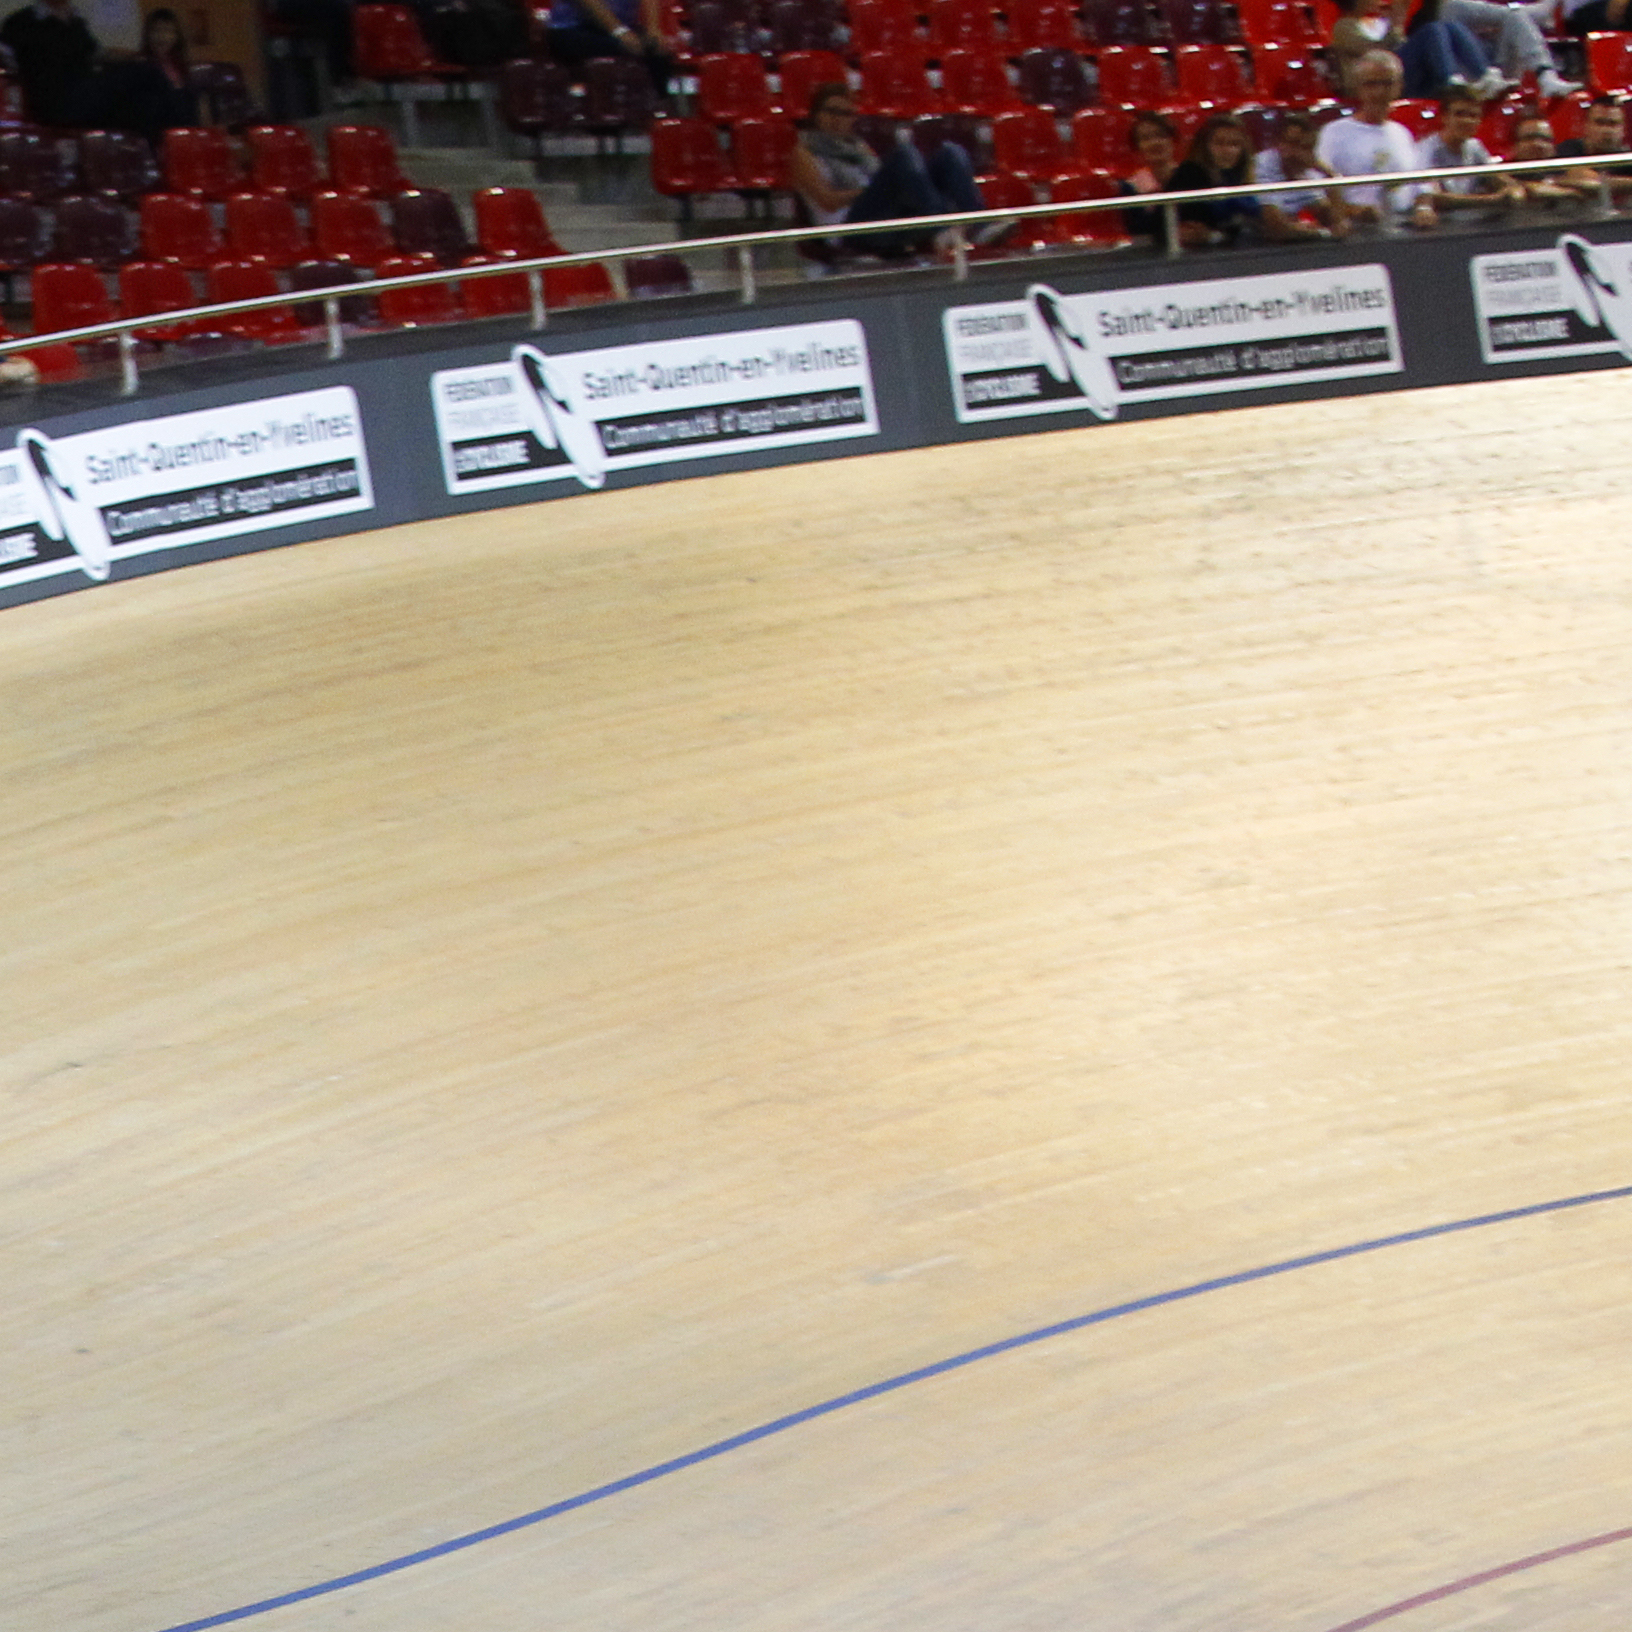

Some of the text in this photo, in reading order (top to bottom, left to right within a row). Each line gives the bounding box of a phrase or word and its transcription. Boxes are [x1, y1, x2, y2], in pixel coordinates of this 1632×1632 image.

[1098, 286, 1385, 337] Saint-Quentin-en-Yvelines
[583, 341, 859, 400] Saint-Quentin-en-Yvelines
[86, 411, 353, 485] Saint-Quentin-en-Yvelines
